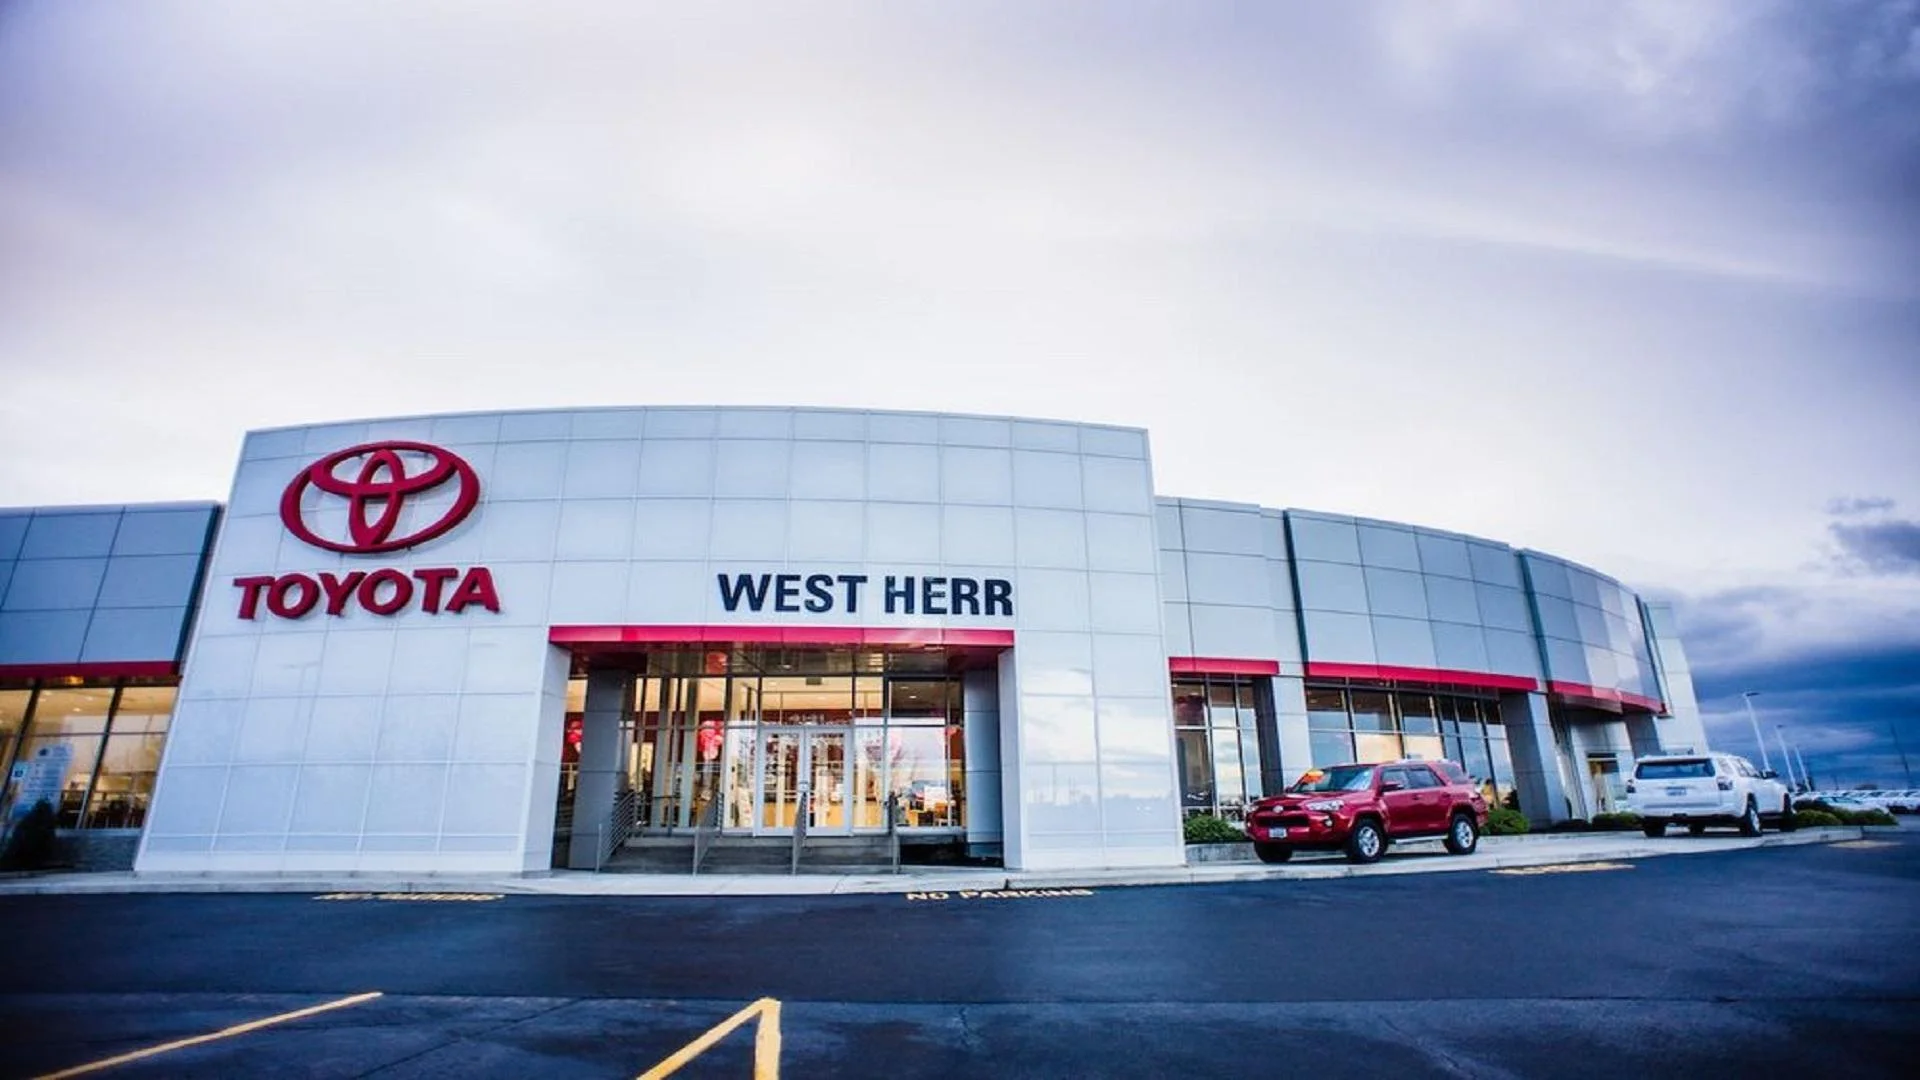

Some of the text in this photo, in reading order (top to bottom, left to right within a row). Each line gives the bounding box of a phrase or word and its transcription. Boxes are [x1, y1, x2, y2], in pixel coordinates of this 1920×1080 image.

[233, 567, 501, 620] TOYOTA
[717, 573, 1013, 616] WEST HERR
[906, 889, 1094, 900] NO PARKING
